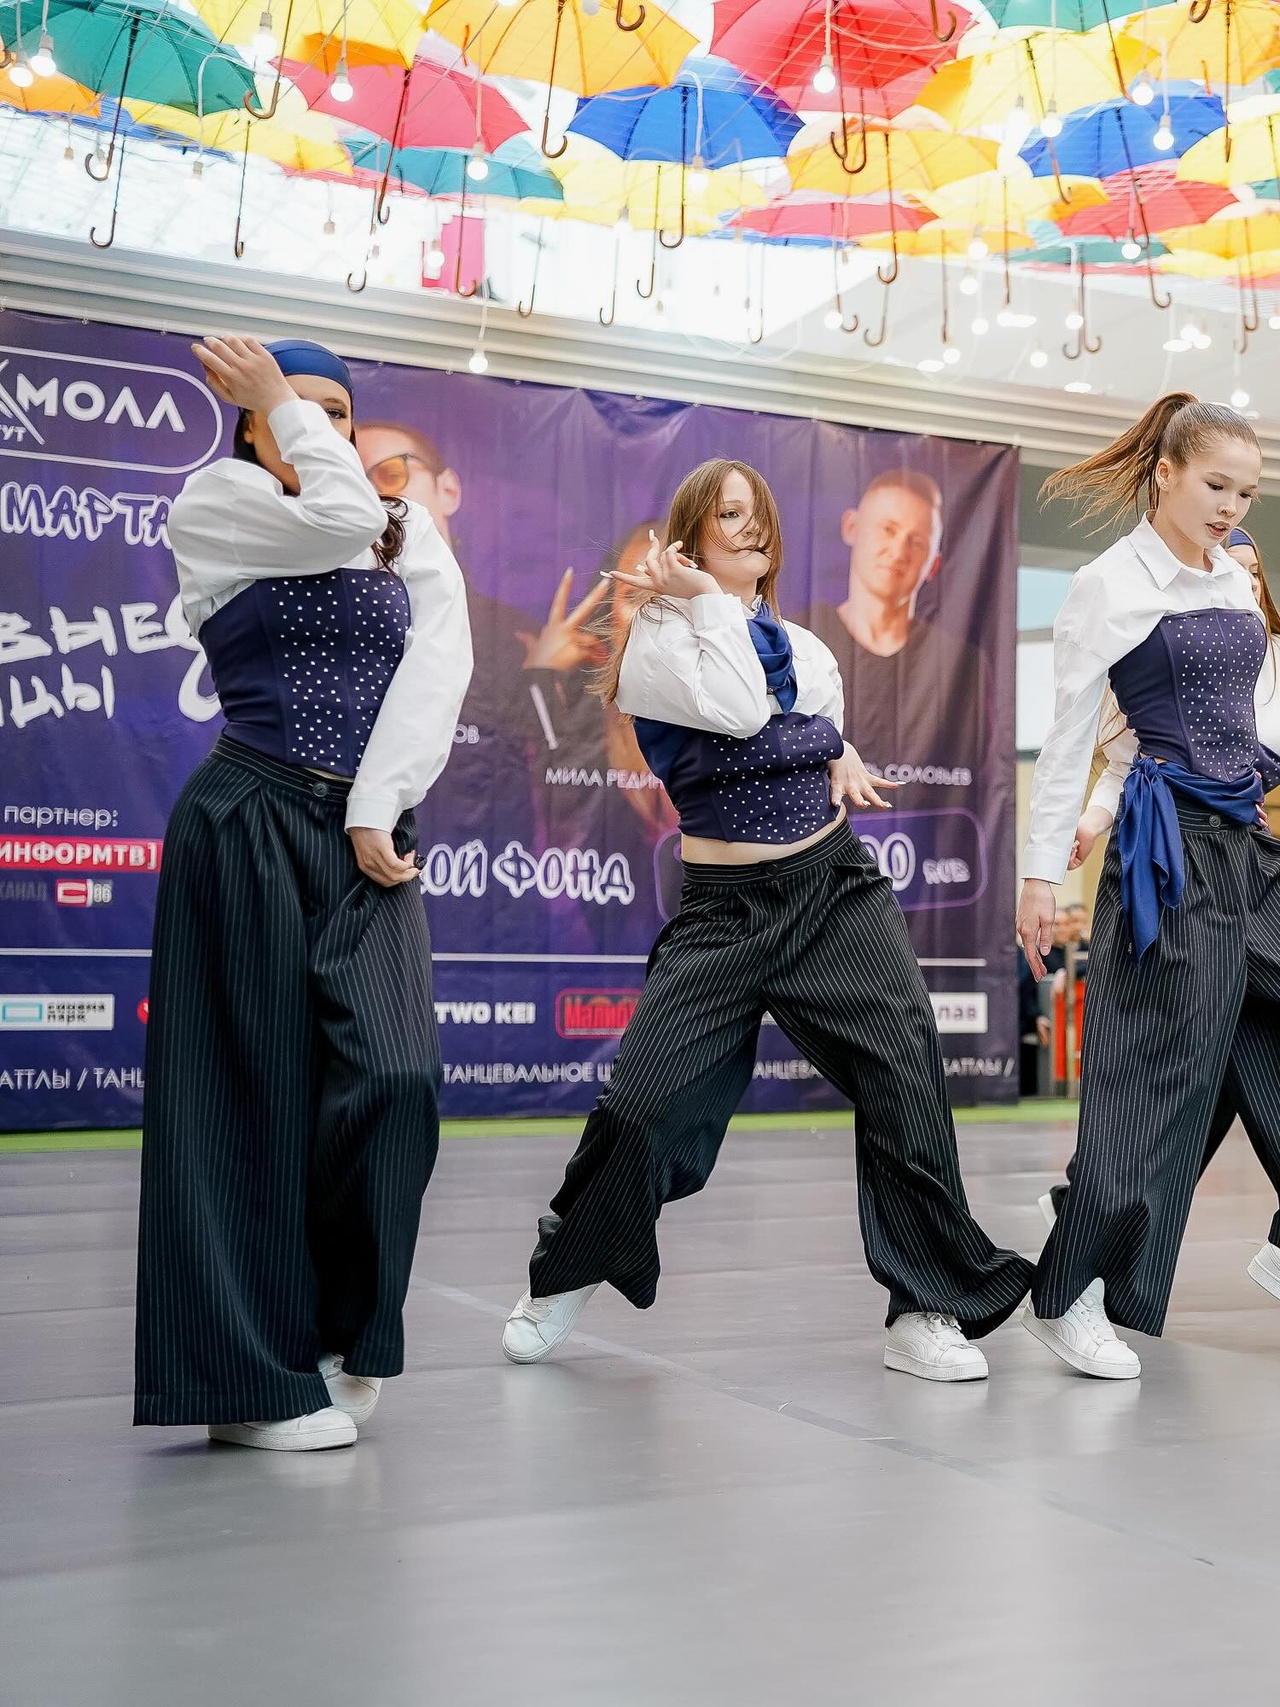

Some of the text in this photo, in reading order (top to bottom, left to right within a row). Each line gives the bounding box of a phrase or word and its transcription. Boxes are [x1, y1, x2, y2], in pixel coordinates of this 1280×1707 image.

[16, 373, 186, 433] МОЛЛ
[0, 481, 172, 549] МАРТА
[0, 663, 115, 729] ЦЫ
[545, 767, 604, 787] МИЛА
[4, 805, 118, 831] партнер:
[492, 841, 635, 905] ФОНД
[434, 1002, 537, 1025] TWO KEI
[0, 1067, 71, 1090] АТТЛЫ
[442, 1061, 594, 1085] ТАНЦЕВАЛЬНОЕ
